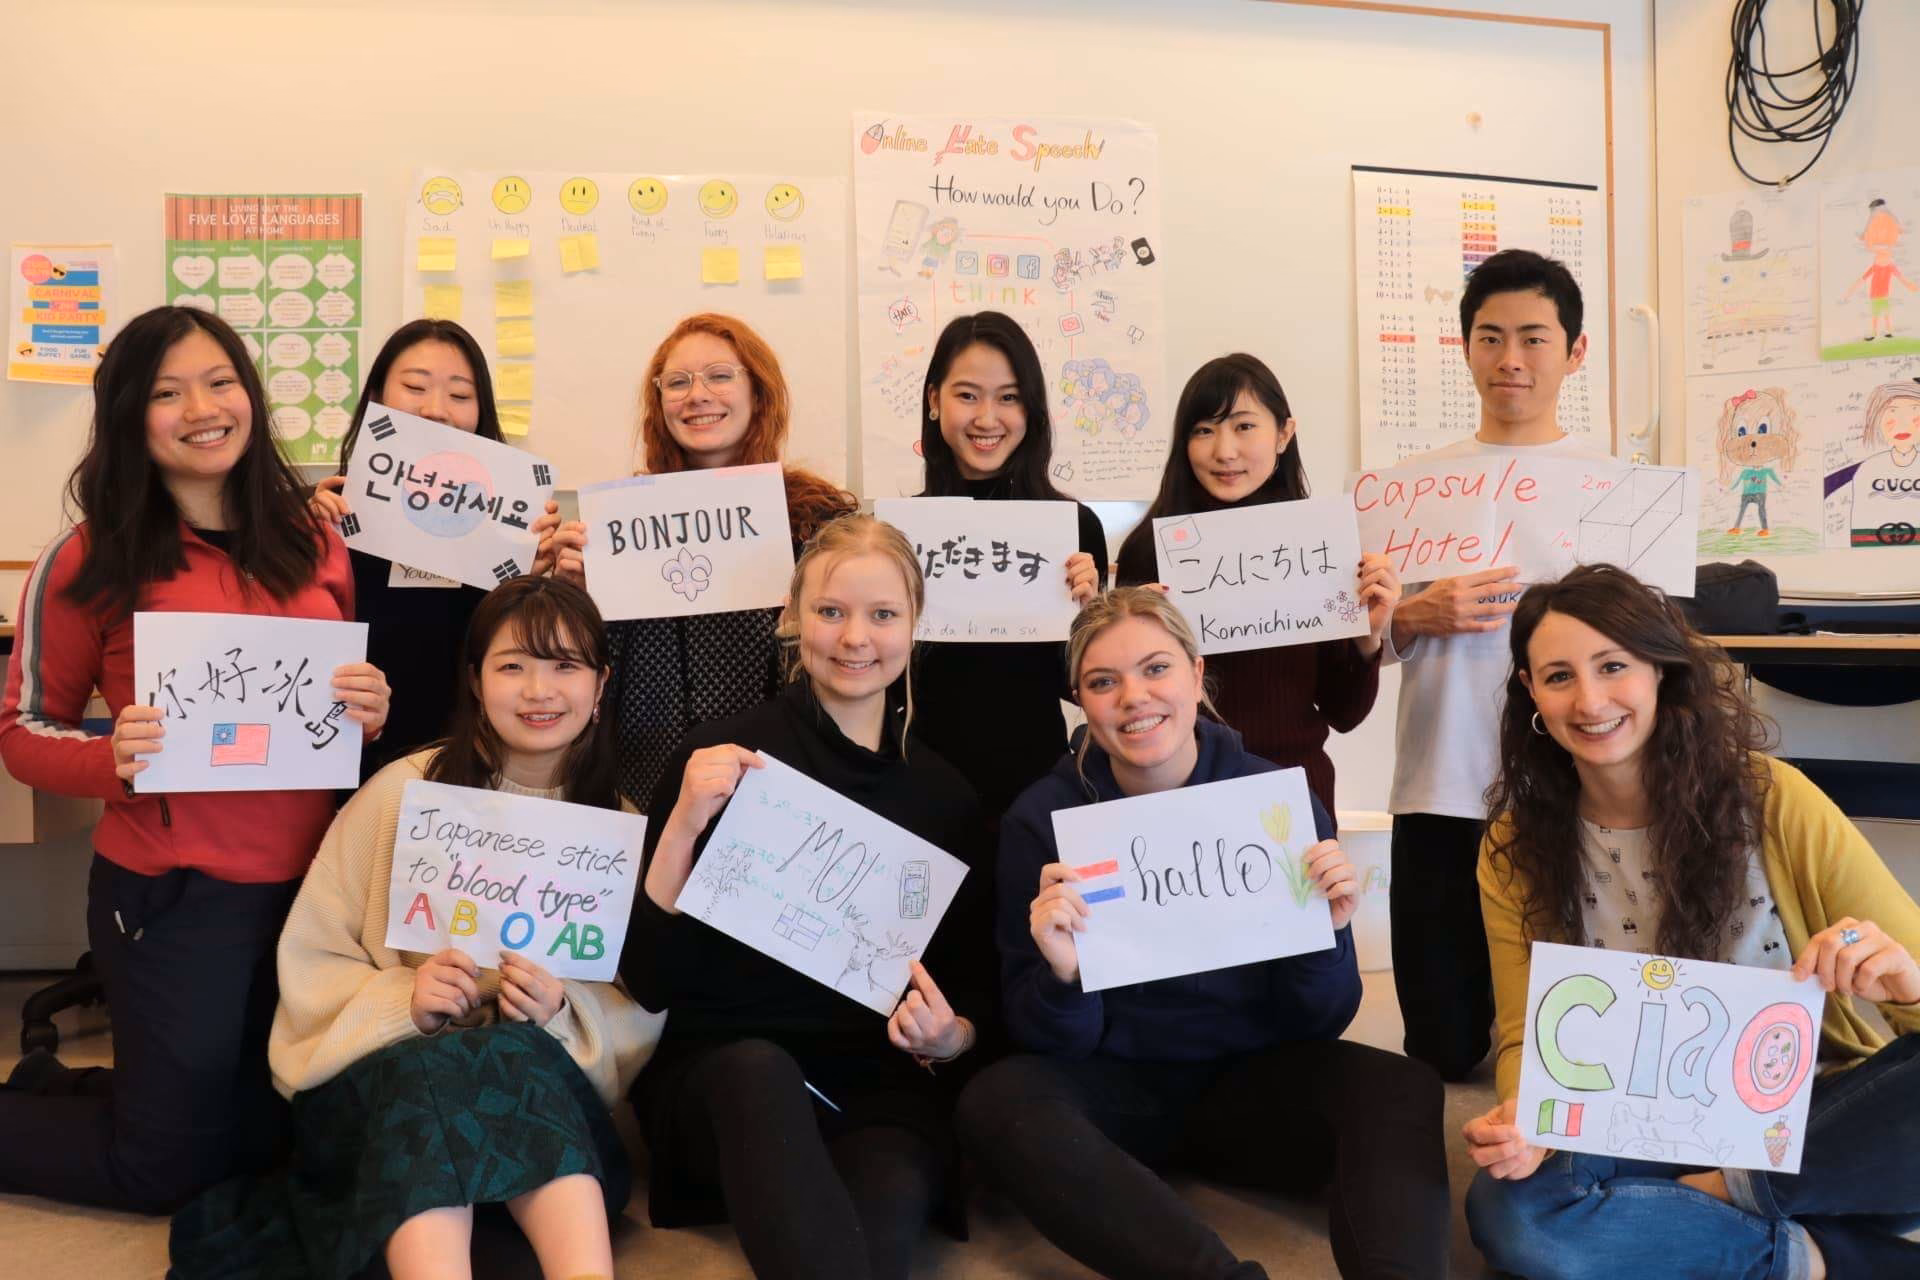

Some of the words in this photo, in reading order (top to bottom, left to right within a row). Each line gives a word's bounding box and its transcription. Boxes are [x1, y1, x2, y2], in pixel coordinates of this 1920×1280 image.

[861, 121, 928, 155] Online
[933, 124, 999, 166] Hate
[189, 214, 217, 225] FIVE
[222, 214, 257, 225] LOVE
[262, 214, 340, 225] LANGUAGES
[230, 204, 259, 212] LIVING
[262, 204, 281, 212] OUT
[283, 204, 299, 212] THE
[929, 175, 977, 205] How
[983, 184, 1034, 207] would
[1038, 193, 1080, 226] you
[1091, 177, 1145, 215] Do?
[35, 288, 96, 297] CARNIVAL
[54, 313, 99, 321] PARTY
[366, 452, 529, 530] 안녕하세요
[1353, 459, 1539, 519] Capsule
[607, 506, 760, 555] BONJOUR
[1384, 520, 1515, 572] Hotel
[1179, 540, 1337, 594] こんにちは
[410, 808, 545, 858] Japanese
[557, 845, 628, 876] stick
[776, 821, 881, 911] MOI
[409, 857, 438, 884] to
[1129, 835, 1272, 907] hallo
[404, 892, 436, 930] A
[449, 899, 478, 936] B
[500, 911, 535, 950] O
[546, 921, 605, 961] AB
[1534, 958, 1814, 1114] Ciao
